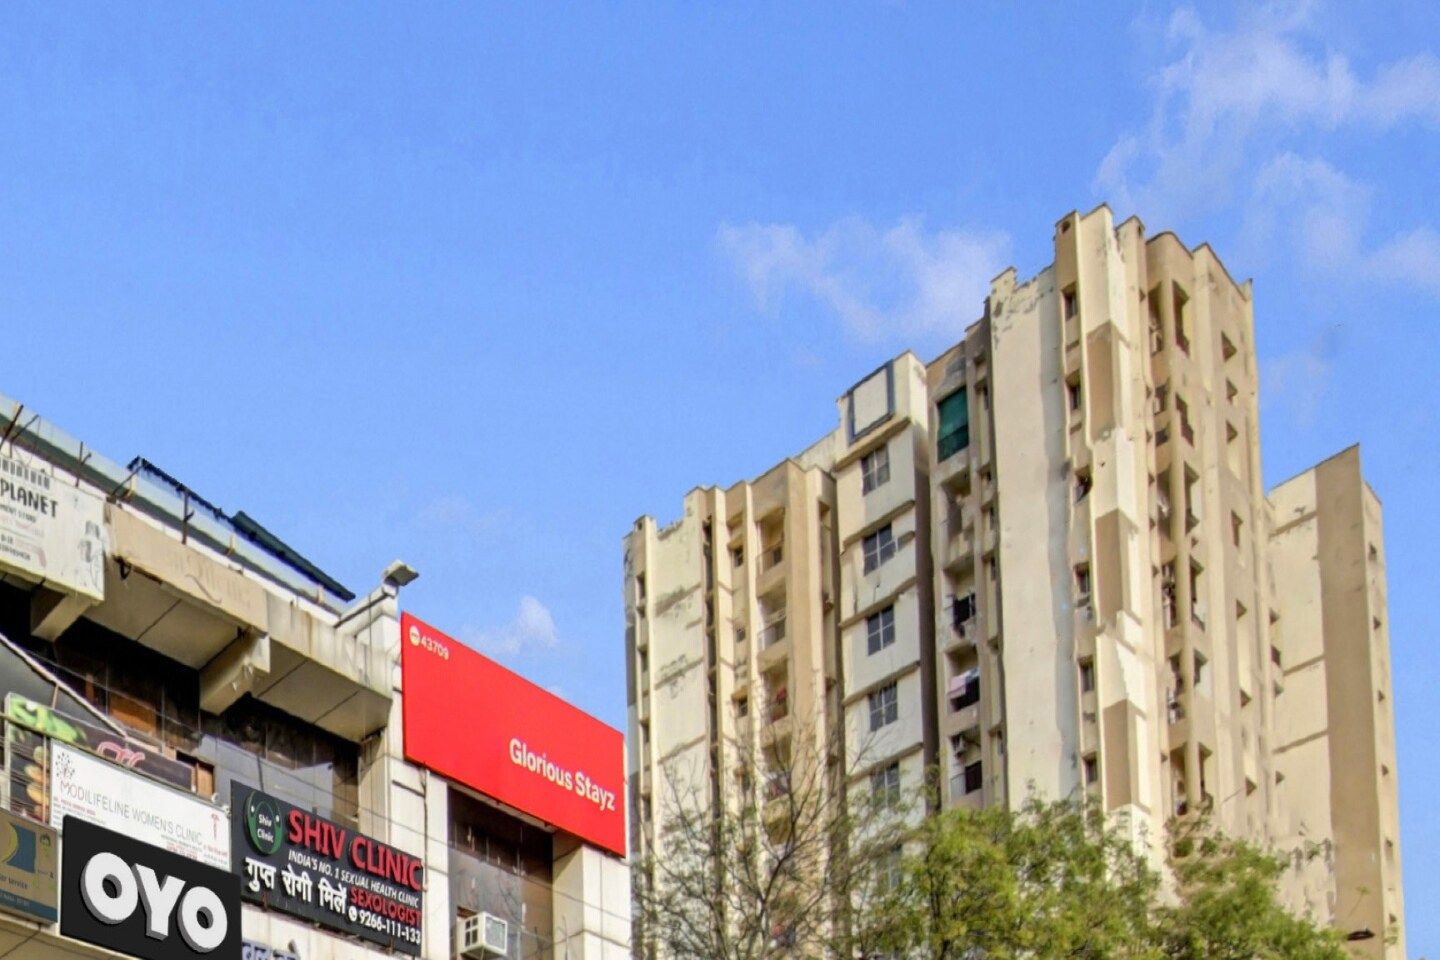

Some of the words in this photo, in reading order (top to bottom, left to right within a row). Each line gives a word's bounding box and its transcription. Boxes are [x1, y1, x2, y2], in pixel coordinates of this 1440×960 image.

[0, 478, 58, 518] PLANET
[420, 635, 450, 660] 43709
[510, 738, 574, 791] Glorious
[574, 771, 617, 813] Stayz
[175, 823, 203, 849] CLINIC
[256, 827, 275, 844] Clinic
[257, 813, 273, 828] Shiv
[287, 808, 347, 860] SHIV
[349, 835, 425, 892] CLINIC
[245, 856, 277, 892] गुप्त
[281, 864, 314, 904] रोगी
[288, 849, 318, 871] INDIA'S
[340, 869, 370, 890] SEXUAL
[370, 879, 398, 900] HEALTH
[398, 888, 420, 906] CLINIC
[79, 851, 229, 953] OYO
[348, 884, 423, 926] SEXOLOGIST
[358, 908, 422, 945] 9266-111-133
